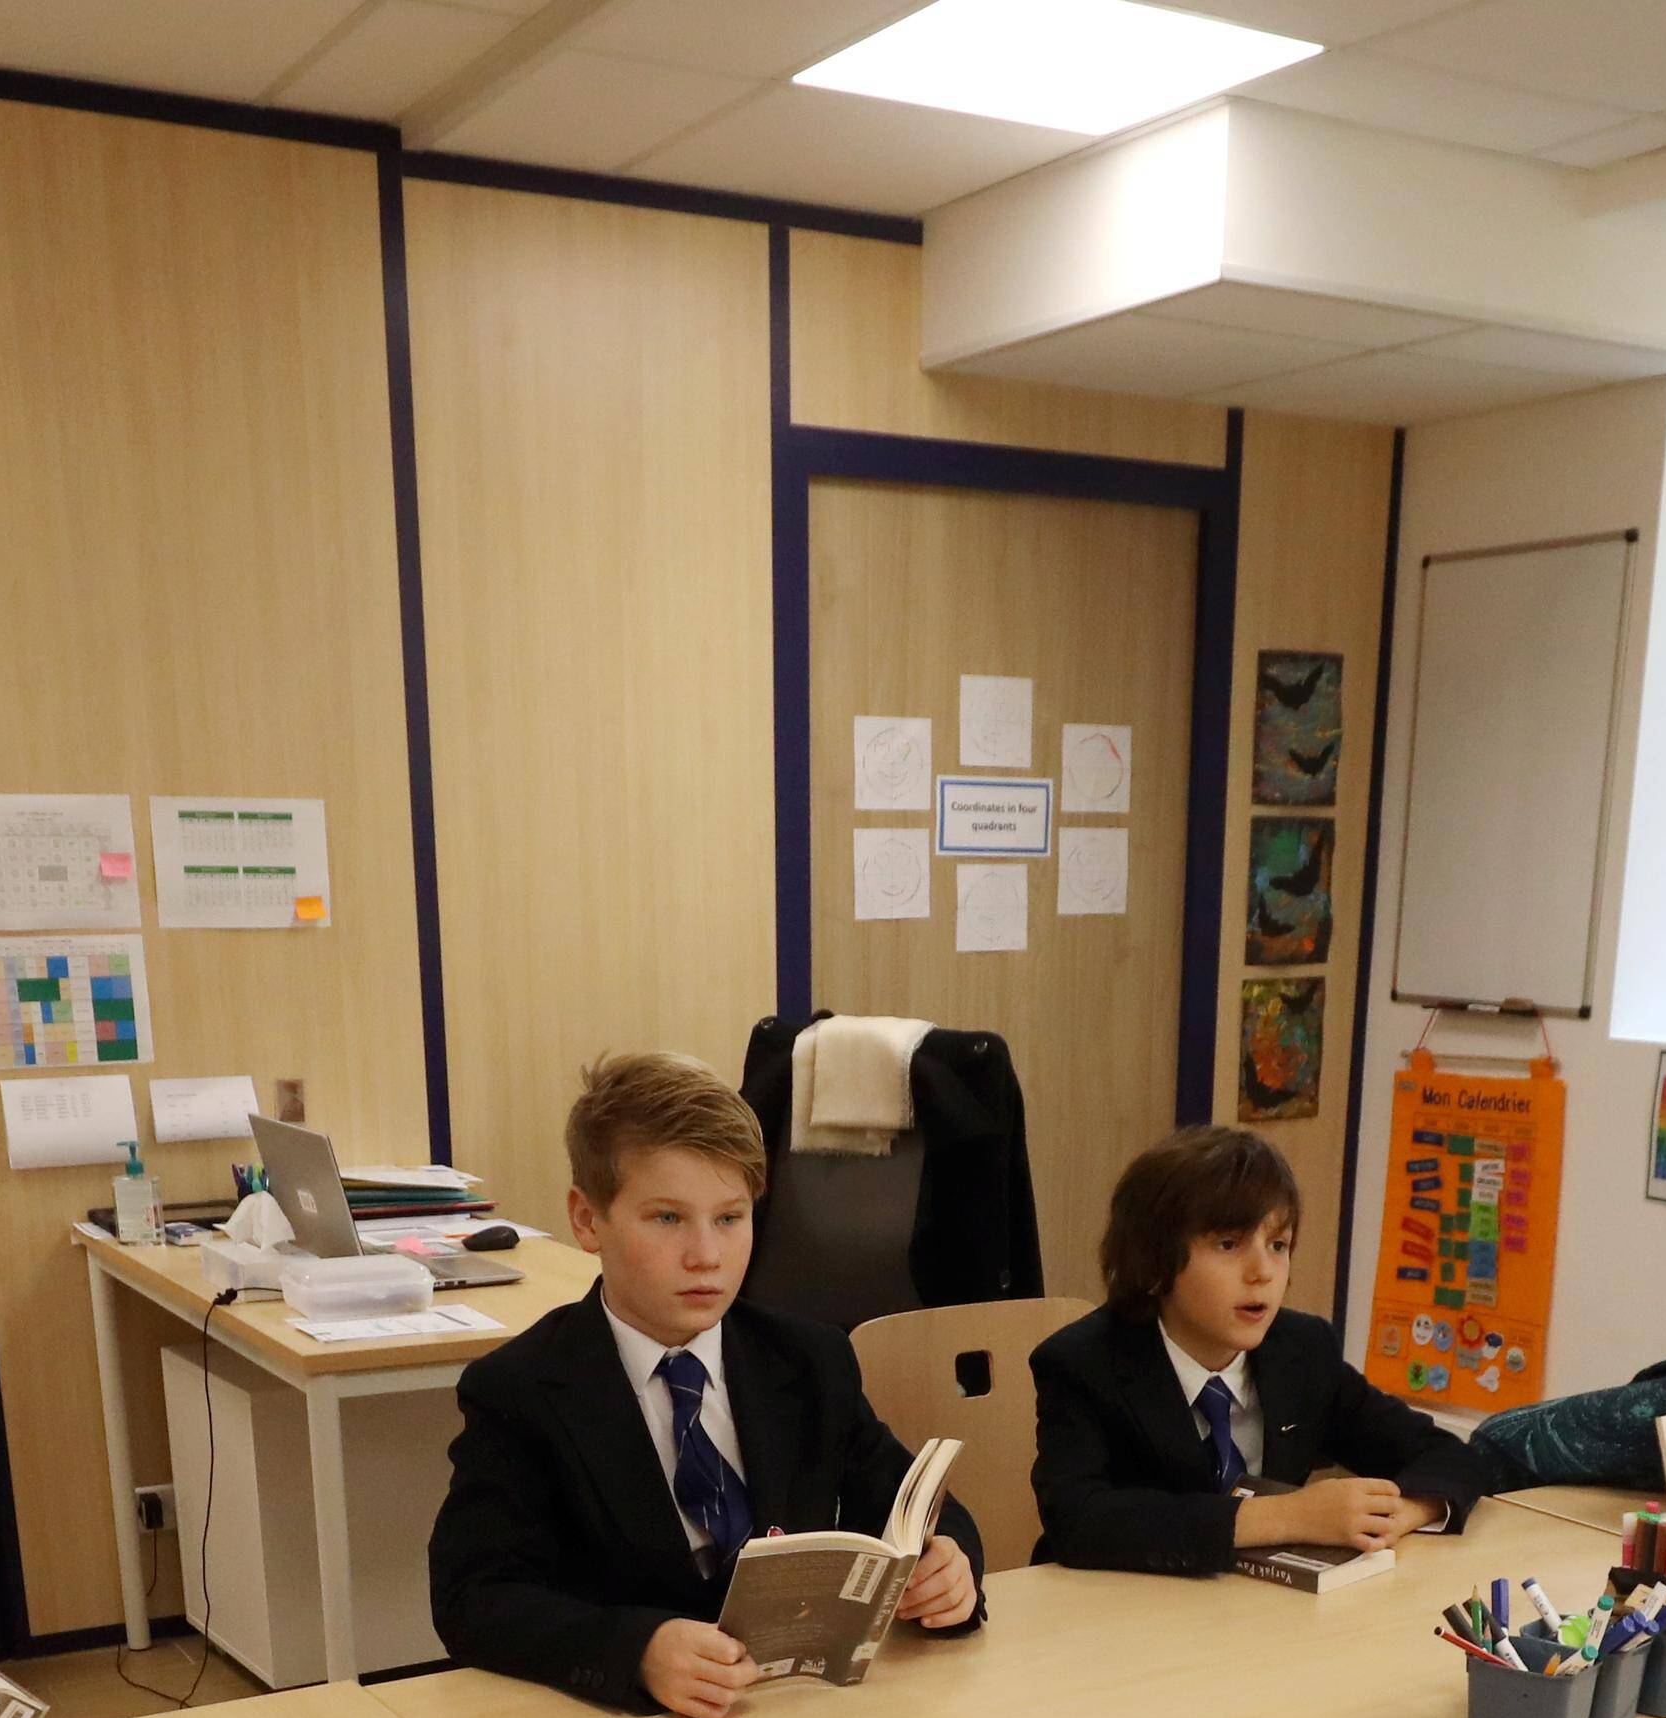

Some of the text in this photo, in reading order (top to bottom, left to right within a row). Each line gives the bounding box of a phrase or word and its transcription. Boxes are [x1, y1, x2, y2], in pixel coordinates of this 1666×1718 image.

[1421, 1086, 1532, 1115] Mon Calendrier
[1235, 1560, 1293, 1585] Varjak Paw
